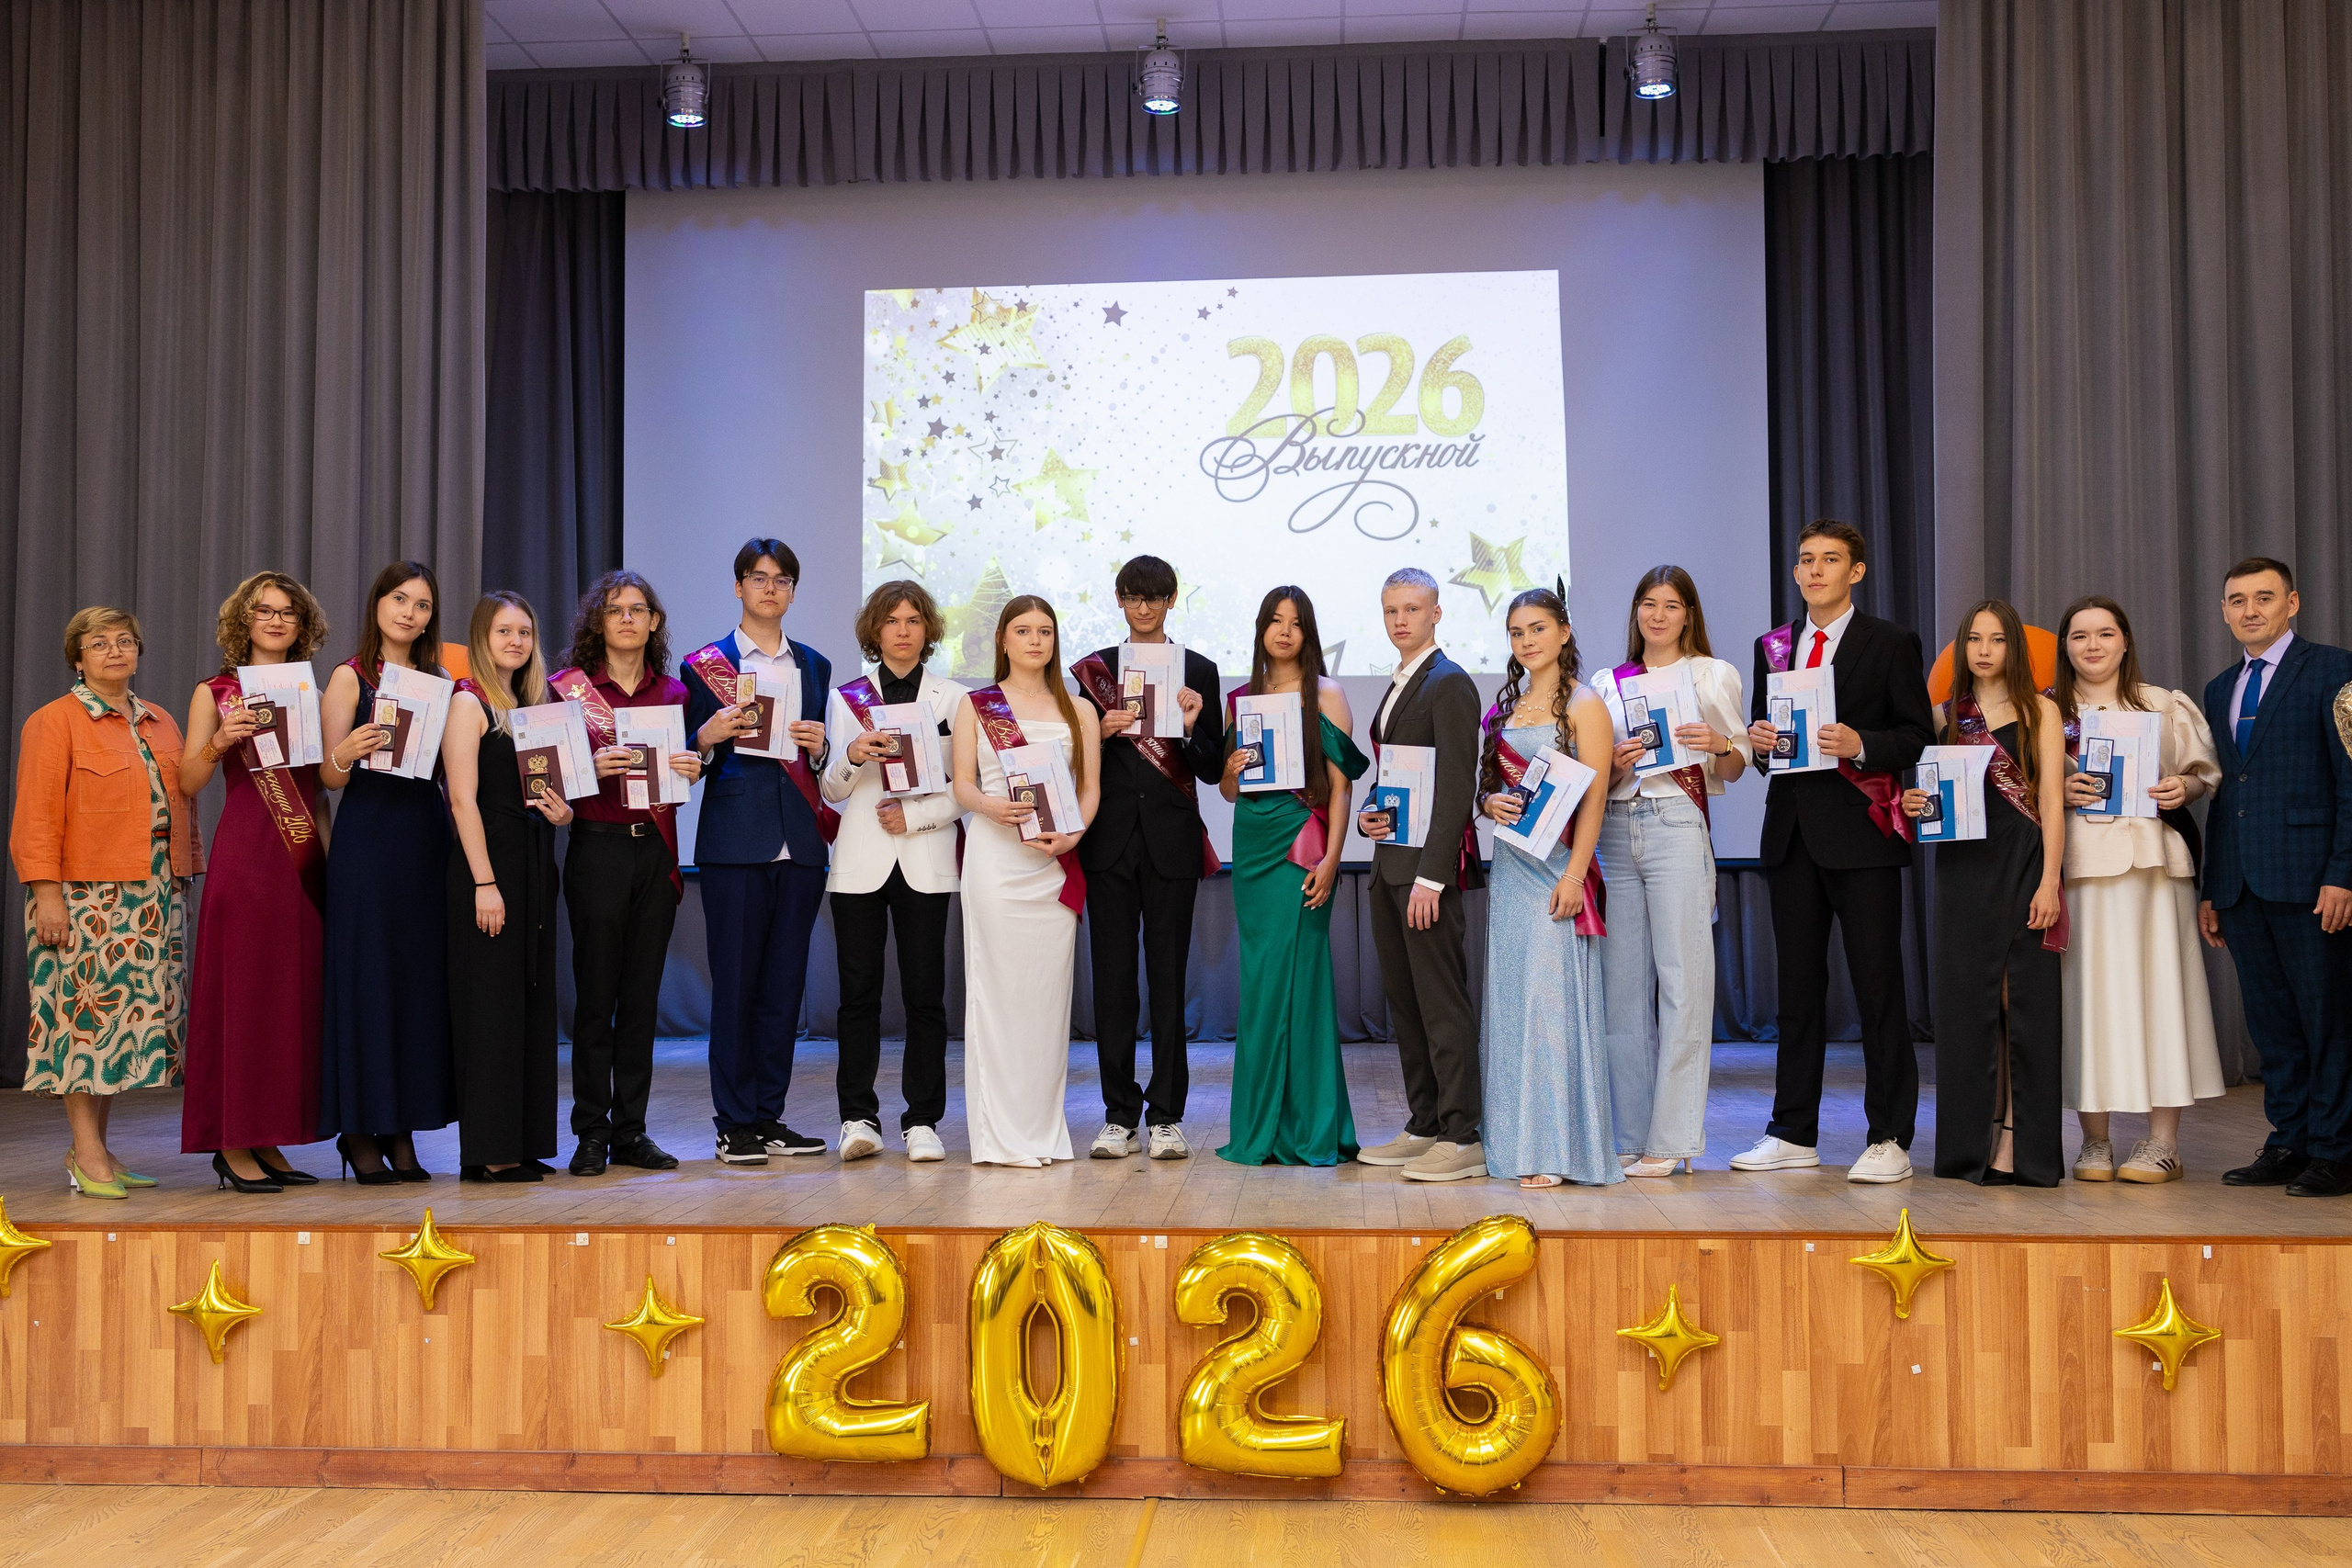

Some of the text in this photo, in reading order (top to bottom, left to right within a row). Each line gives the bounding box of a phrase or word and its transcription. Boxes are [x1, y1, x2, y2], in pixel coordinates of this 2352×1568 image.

[1227, 332, 1485, 438] 2026
[1200, 406, 1486, 540] Выпускной
[282, 816, 314, 843] 2026
[761, 1213, 1565, 1499] 2026
